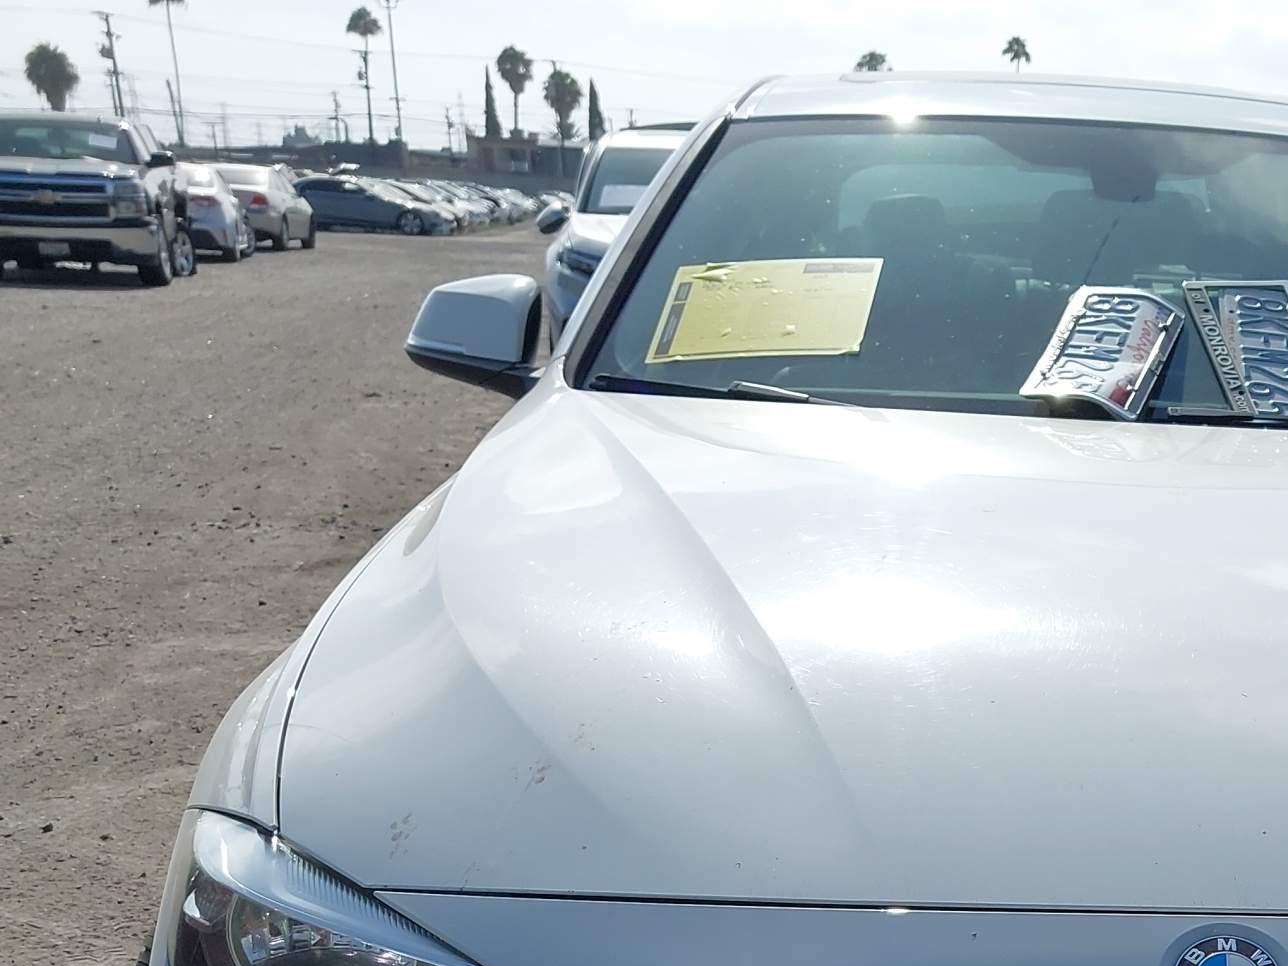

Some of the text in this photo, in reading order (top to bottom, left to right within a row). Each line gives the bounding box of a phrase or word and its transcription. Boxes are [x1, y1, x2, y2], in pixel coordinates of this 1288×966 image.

[1191, 293, 1206, 304] of
[1200, 314, 1242, 391] MONROVIA
[1183, 938, 1273, 966] BMW
